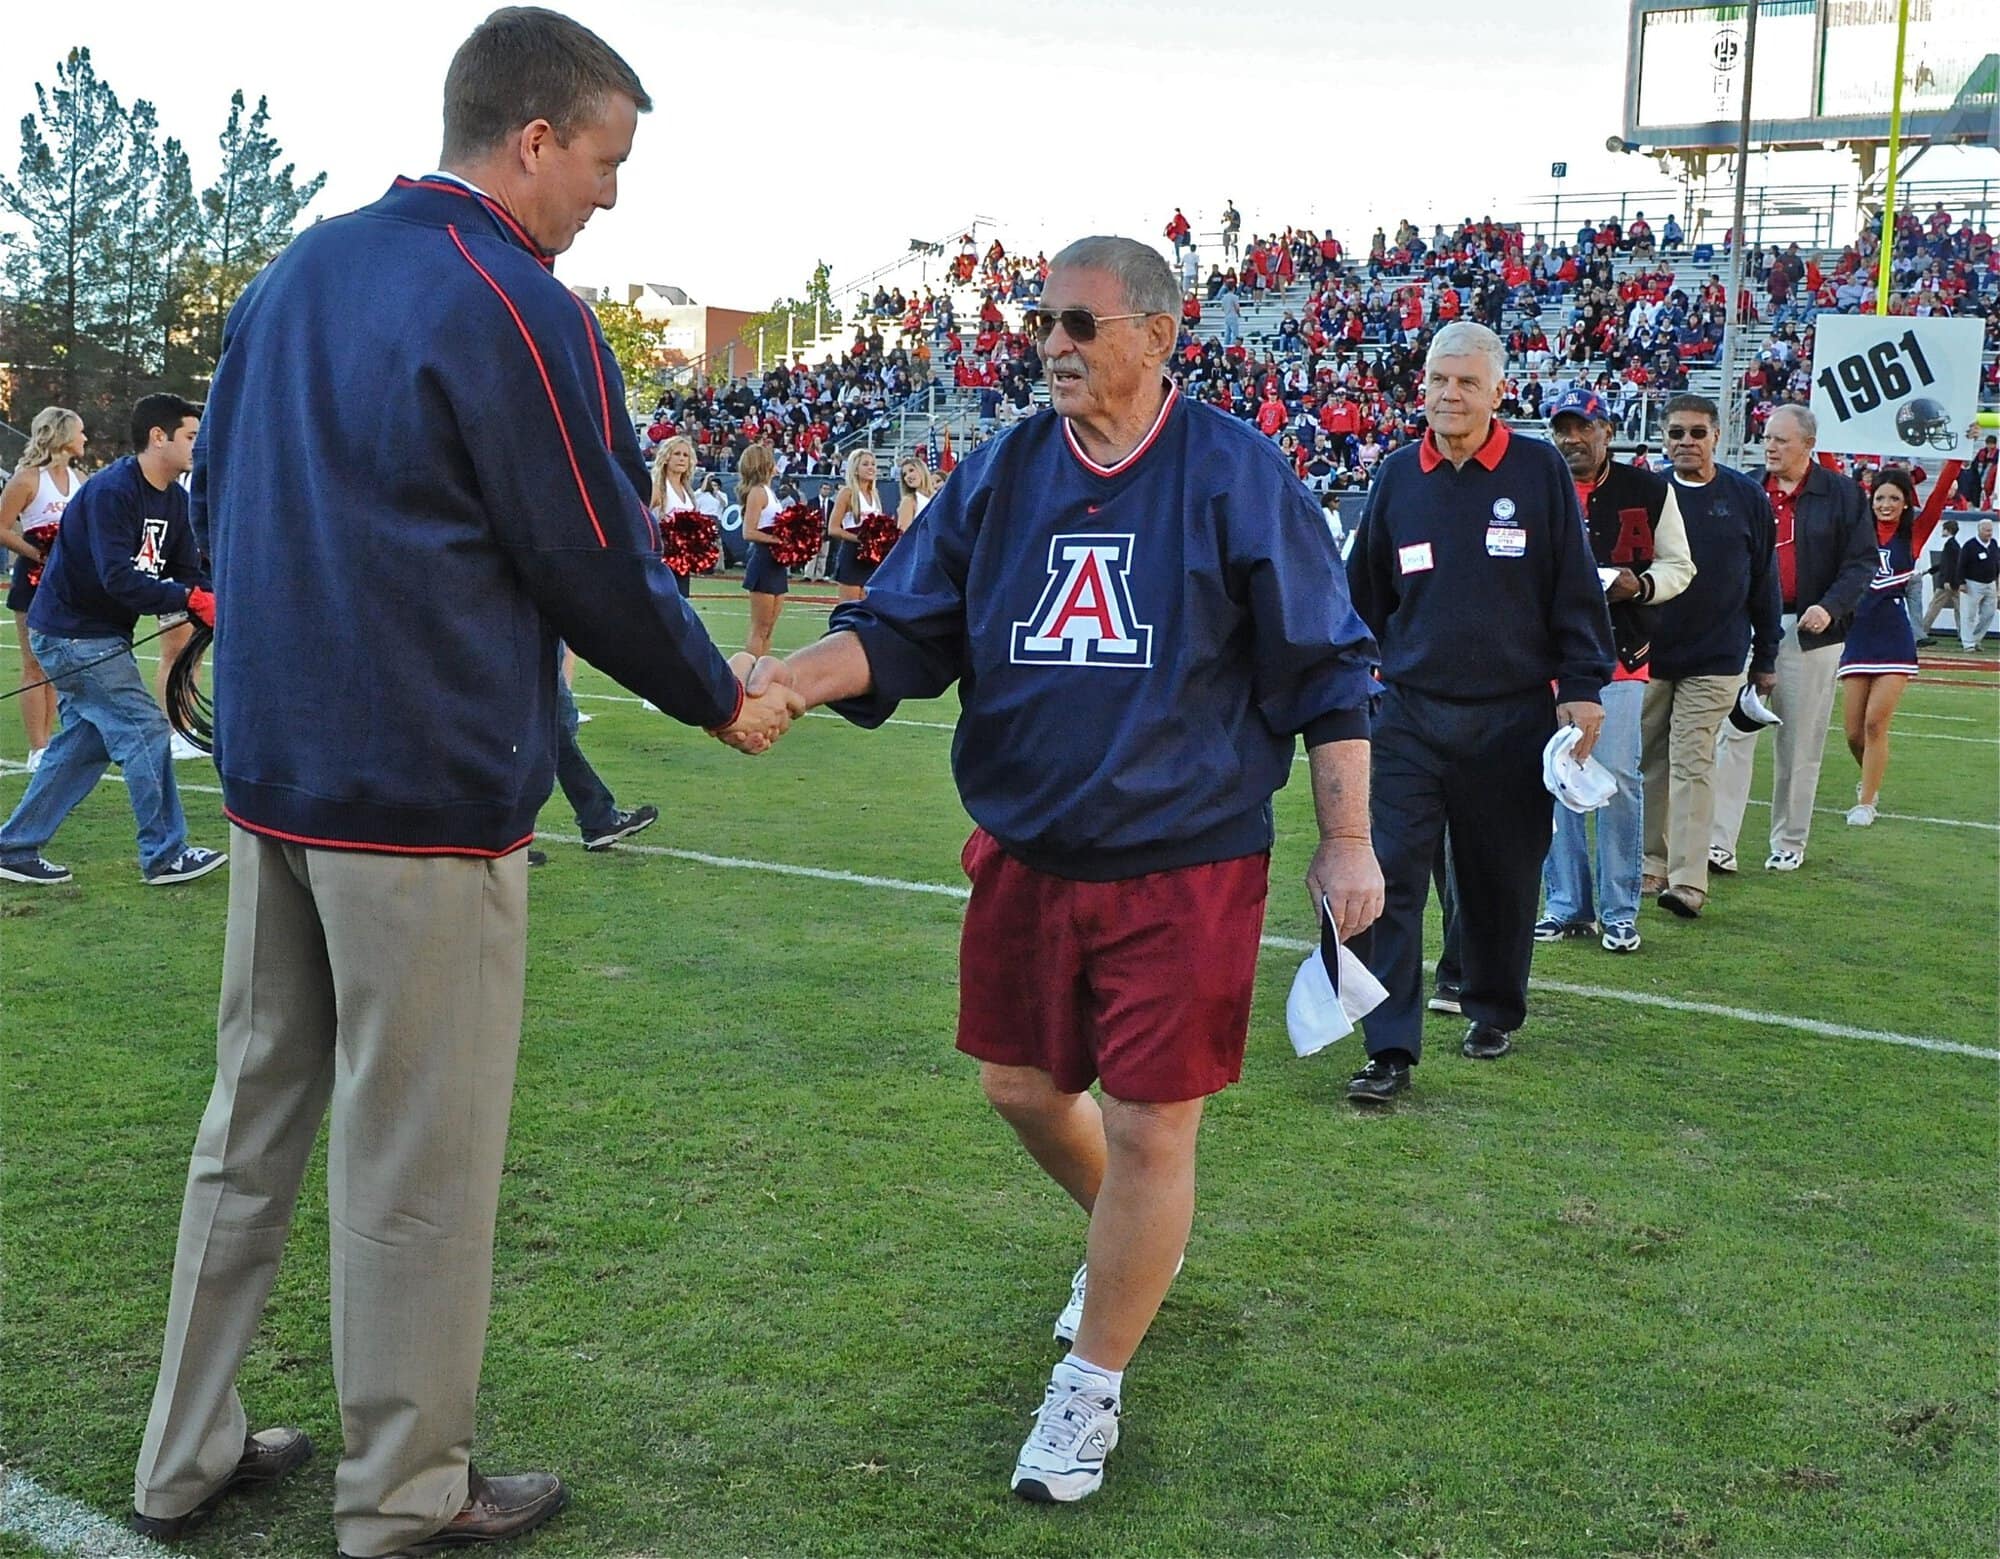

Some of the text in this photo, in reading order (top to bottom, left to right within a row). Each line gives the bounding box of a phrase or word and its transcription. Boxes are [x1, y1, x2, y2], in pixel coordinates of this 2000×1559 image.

[1553, 163, 1565, 177] 27
[1817, 329, 1935, 422] 1961
[130, 518, 168, 580] A
[1610, 507, 1655, 563] A
[1010, 533, 1153, 668] A
